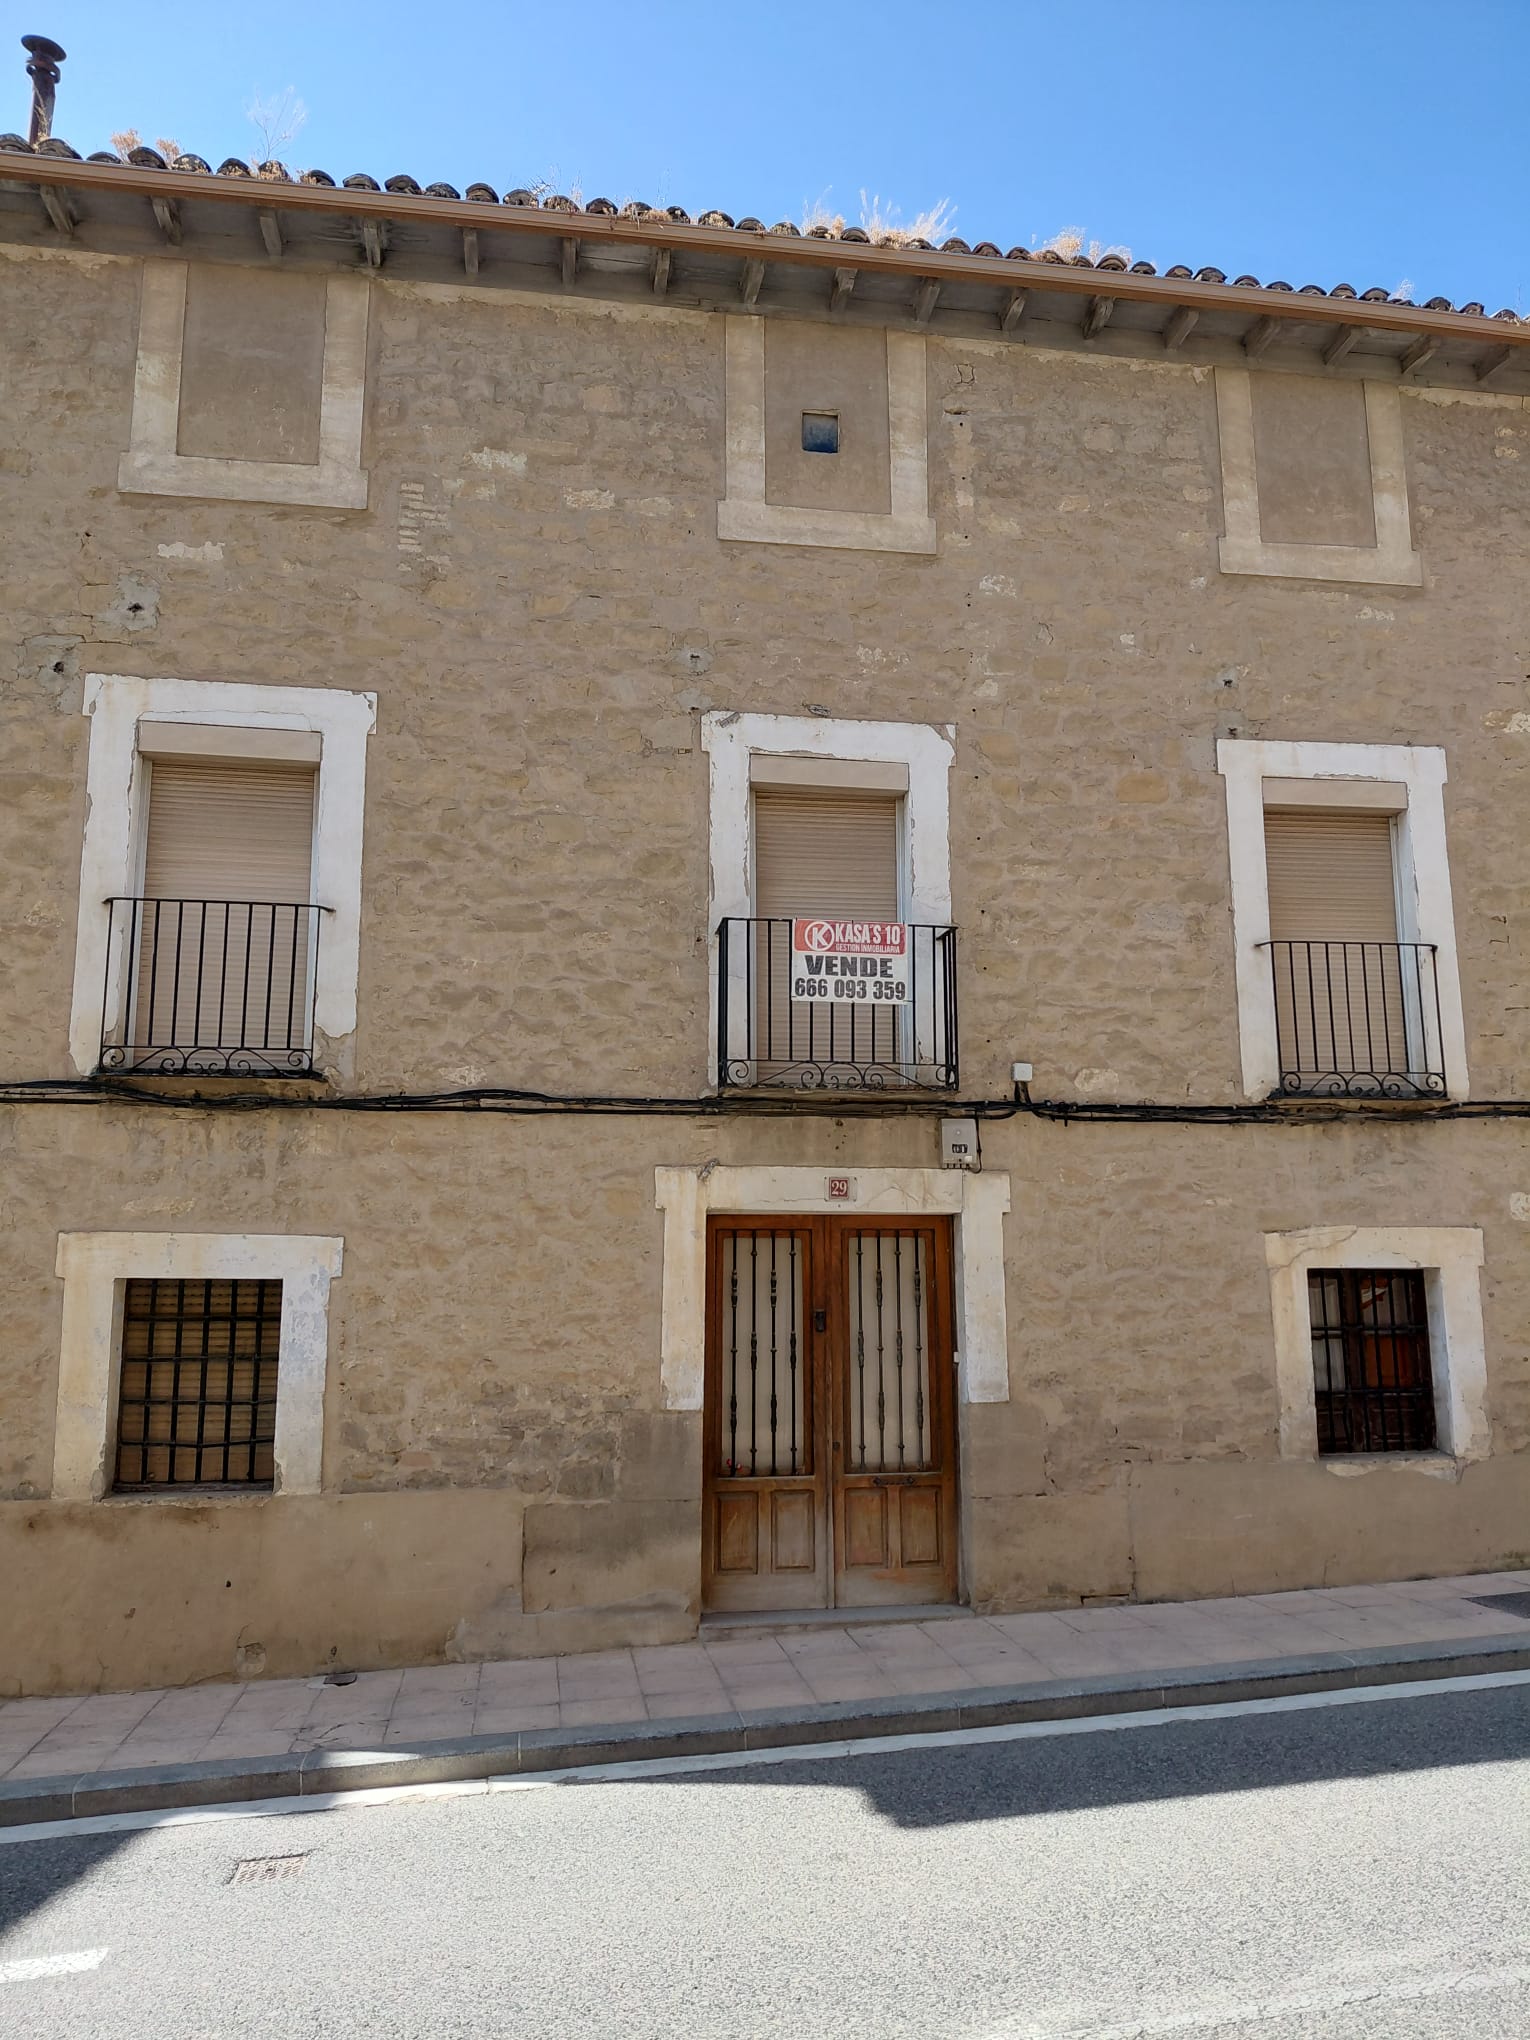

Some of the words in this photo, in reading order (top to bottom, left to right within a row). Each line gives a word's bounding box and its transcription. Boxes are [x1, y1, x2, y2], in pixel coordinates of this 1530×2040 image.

[835, 922, 882, 945] KASA'S
[885, 924, 900, 945] 10
[861, 943, 900, 953] INMOBILIARIA
[804, 955, 894, 978] VENDE
[795, 978, 828, 997] 666
[834, 979, 867, 999] 093
[873, 980, 906, 1000] 359
[831, 1181, 847, 1195] 29
